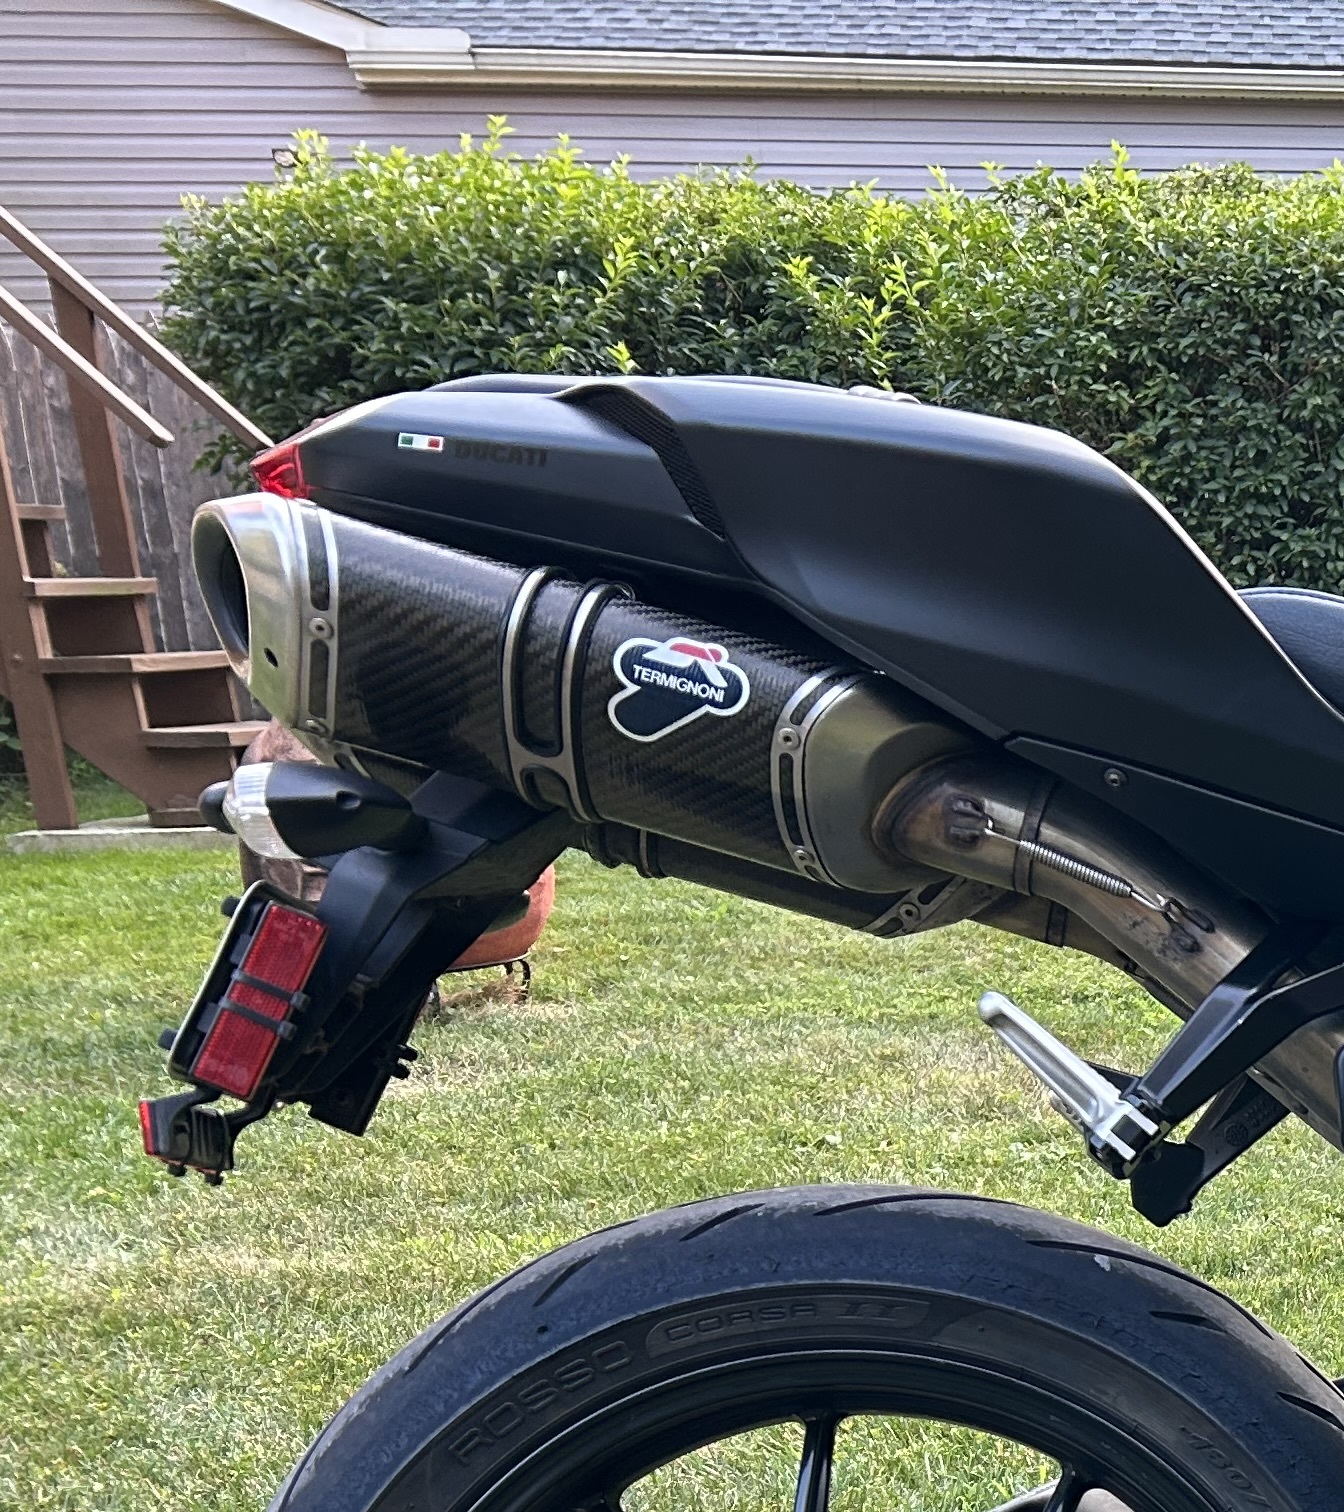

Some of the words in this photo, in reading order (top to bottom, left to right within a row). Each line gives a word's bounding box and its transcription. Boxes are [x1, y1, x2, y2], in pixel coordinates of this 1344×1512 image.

[454, 439, 548, 467] DUCATI
[632, 664, 726, 703] TERMIGNONI
[447, 1340, 634, 1467] ROSSO
[661, 1301, 823, 1342] CORSA
